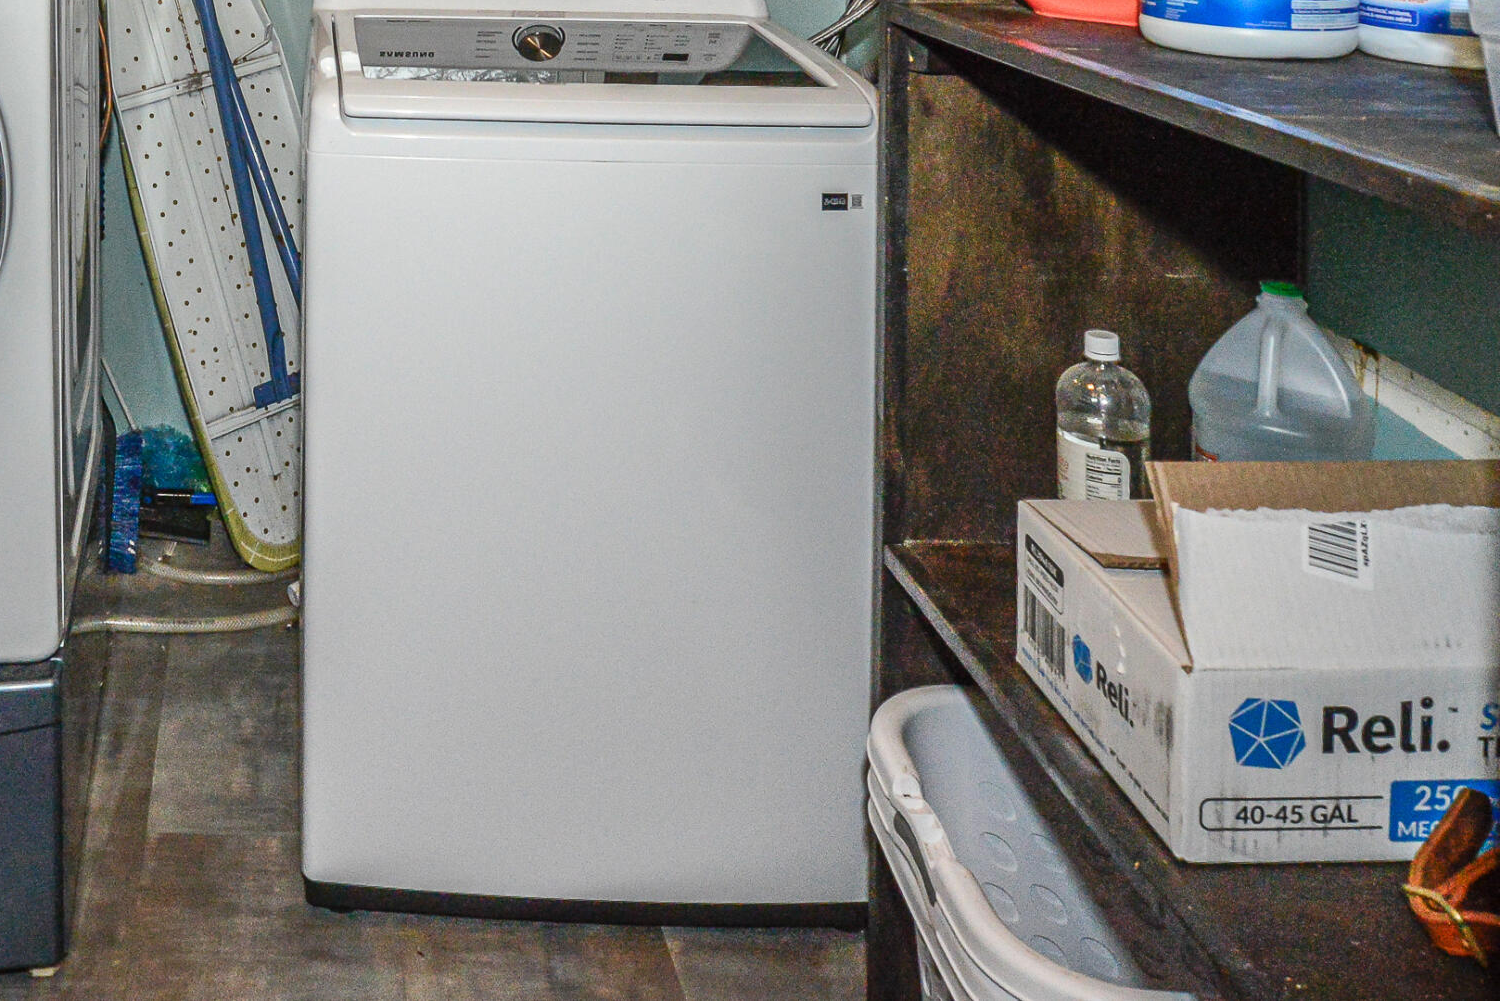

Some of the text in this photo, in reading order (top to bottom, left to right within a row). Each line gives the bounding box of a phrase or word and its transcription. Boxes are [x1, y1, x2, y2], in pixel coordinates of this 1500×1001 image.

[1095, 660, 1134, 728] Reli.
[1321, 695, 1451, 754] Reli.
[1235, 804, 1359, 825] 40-45 GAL
